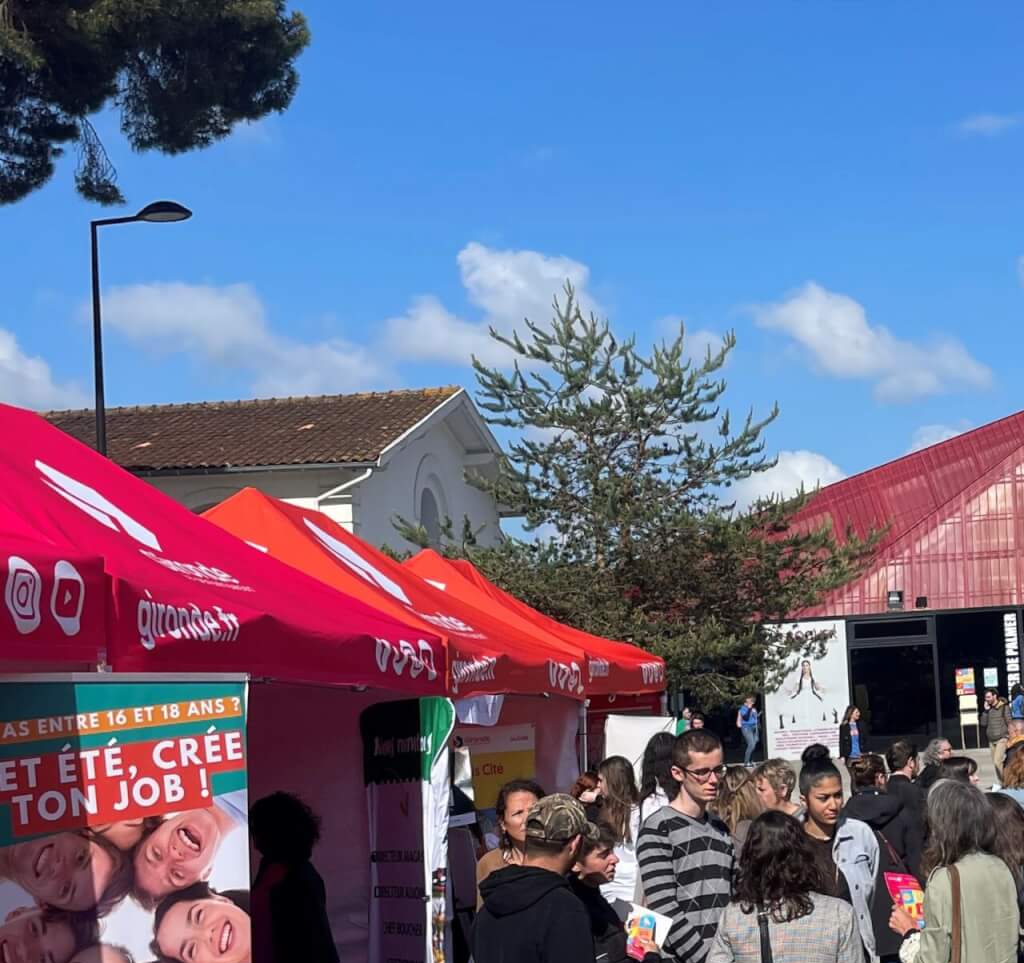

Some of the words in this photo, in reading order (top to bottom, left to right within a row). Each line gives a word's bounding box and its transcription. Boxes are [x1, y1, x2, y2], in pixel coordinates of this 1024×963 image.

[138, 589, 240, 650] gironde.fr
[1003, 614, 1019, 656] PALMER
[2, 723, 29, 738] AS
[37, 713, 99, 735] ENTRE
[107, 711, 127, 726] 16
[134, 707, 155, 724] ET
[160, 703, 180, 720] 18
[187, 698, 225, 717] ANS
[231, 697, 241, 712] ?
[0, 757, 41, 792] ET
[58, 737, 138, 785] ÉTÉ,
[152, 725, 242, 770] CRÉE
[12, 784, 98, 825] TON
[113, 774, 185, 812] JOB
[199, 768, 209, 798] !
